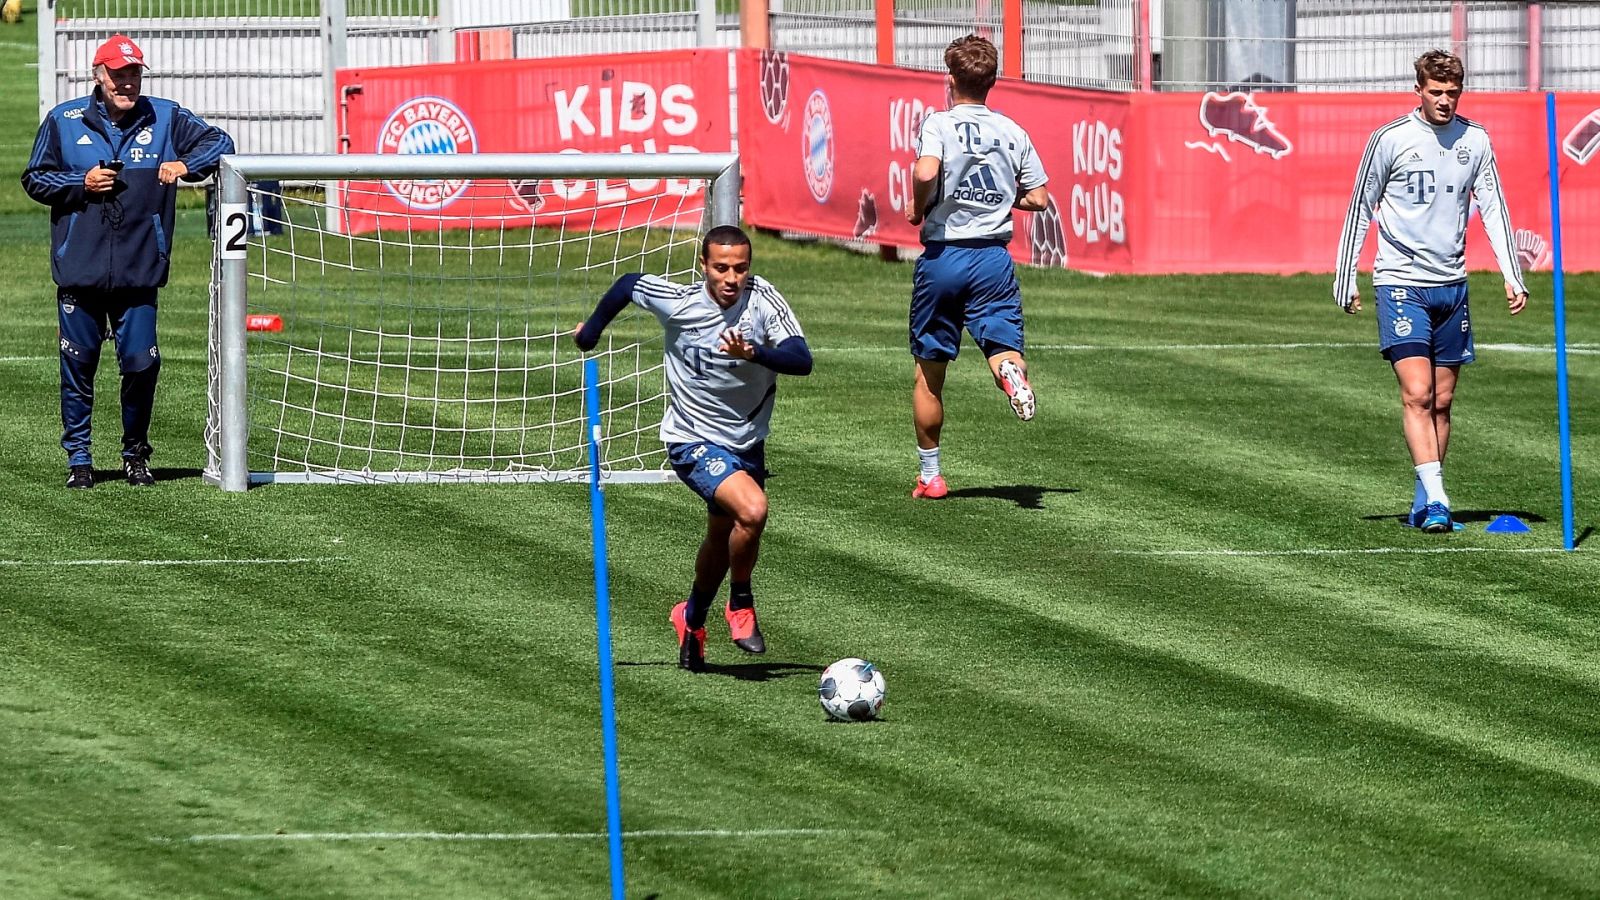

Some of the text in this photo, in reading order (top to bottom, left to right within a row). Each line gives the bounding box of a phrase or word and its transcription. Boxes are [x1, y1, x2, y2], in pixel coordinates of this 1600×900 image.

[385, 102, 470, 148] FC BAYERN
[1072, 119, 1123, 181] KIDS
[952, 187, 1004, 206] adidas
[1071, 182, 1126, 244] CLUB
[225, 212, 247, 252] 2
